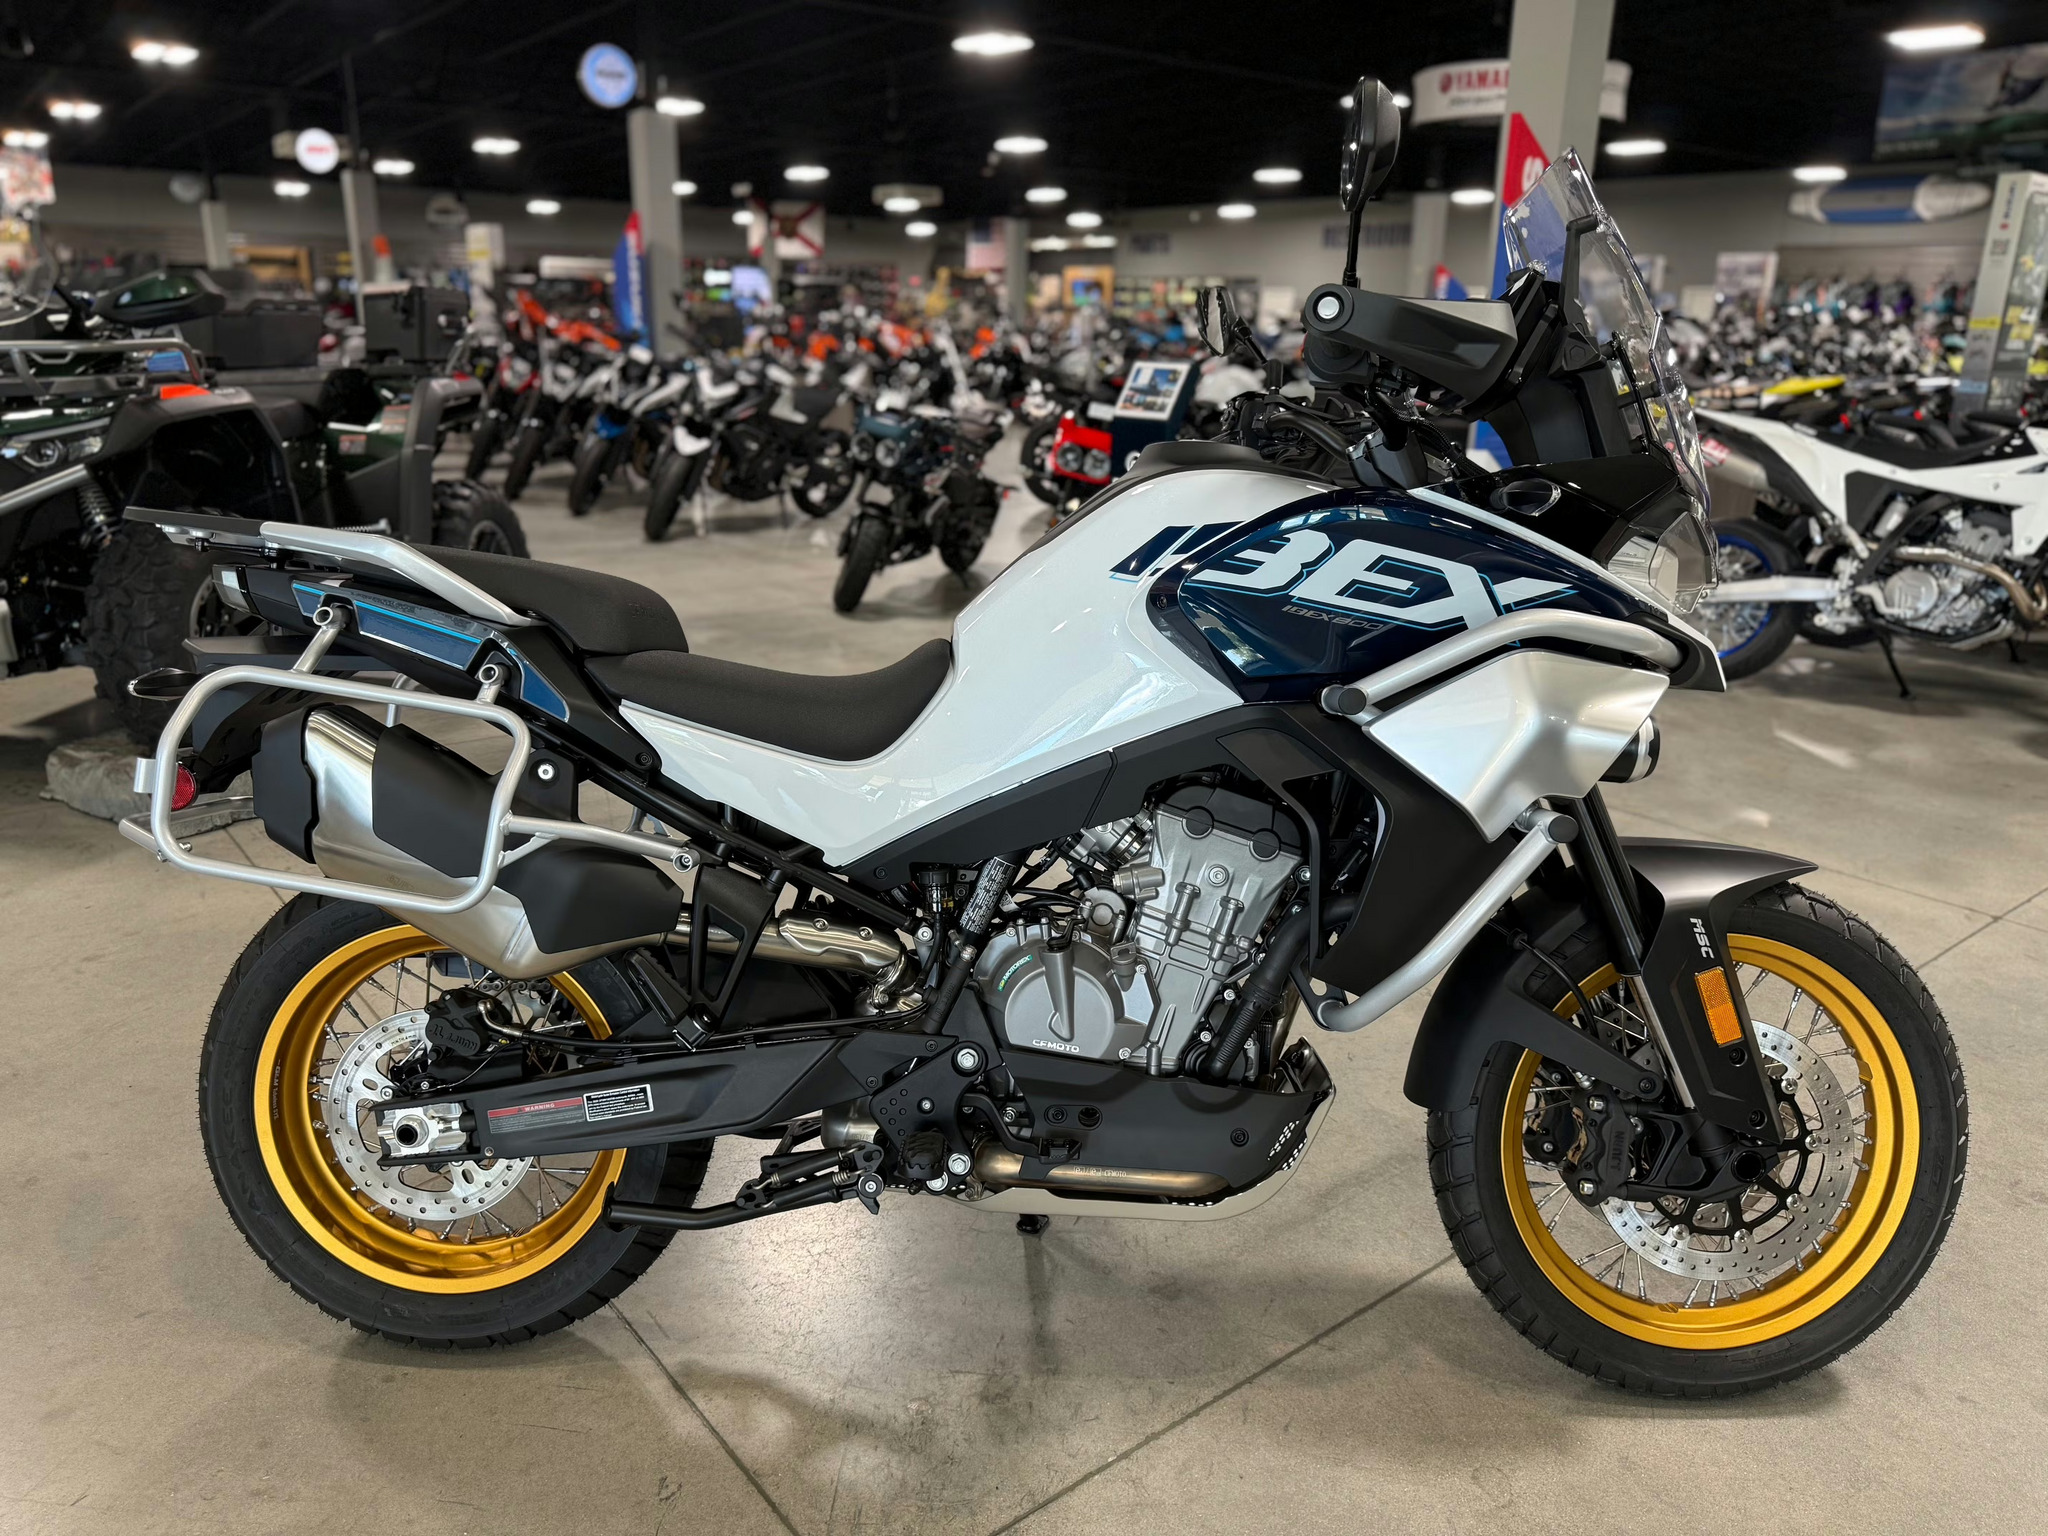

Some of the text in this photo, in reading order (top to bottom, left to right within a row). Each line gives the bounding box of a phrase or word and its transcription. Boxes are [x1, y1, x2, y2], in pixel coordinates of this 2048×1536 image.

[1689, 917, 1715, 959] MSC
[1032, 1039, 1080, 1054] CFMOTO
[524, 1103, 556, 1112] WARNING
